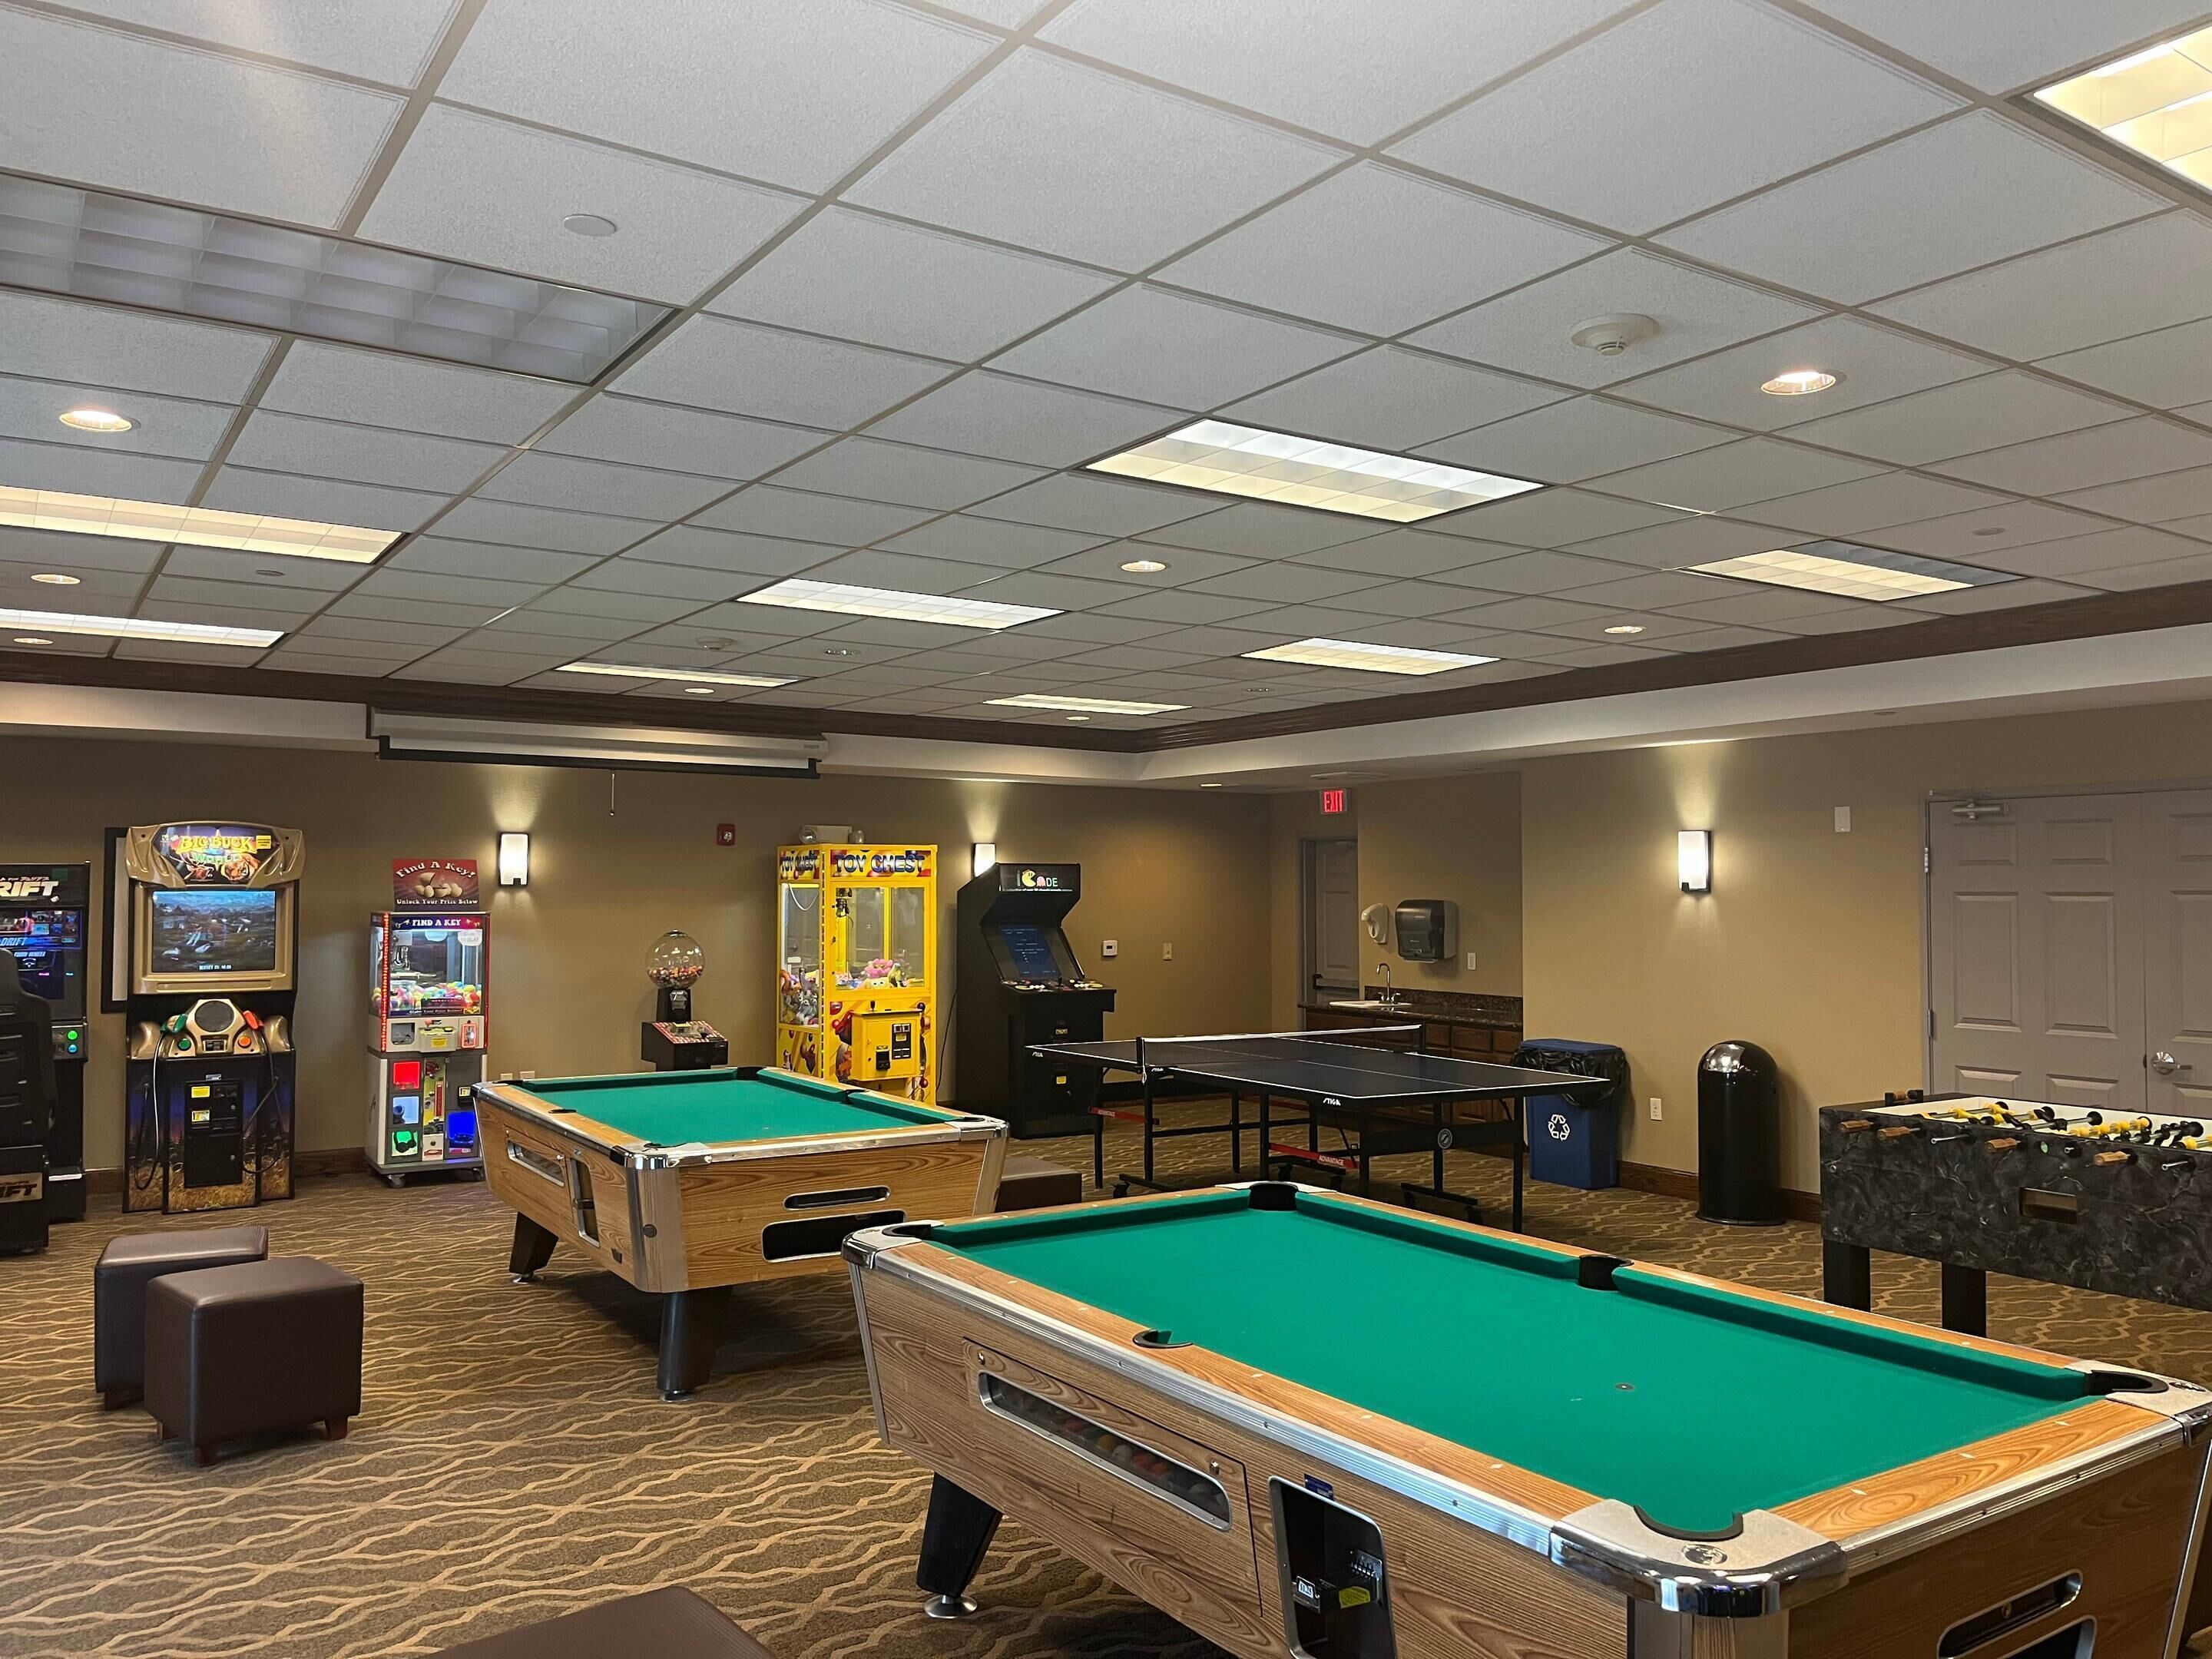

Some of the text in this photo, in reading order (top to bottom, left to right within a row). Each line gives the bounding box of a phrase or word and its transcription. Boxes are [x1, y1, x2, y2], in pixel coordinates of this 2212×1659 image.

[1323, 790, 1343, 813] EXIT
[180, 836, 210, 850] BIG
[211, 835, 253, 849] BUCK
[396, 863, 425, 877] Find
[445, 862, 475, 878] Key!
[780, 855, 794, 872] TOY
[835, 854, 925, 873] TOY CHEST
[0, 937, 28, 946] DRIFT
[1323, 1098, 1341, 1106] STIGA
[1319, 1155, 1344, 1167] ADVANTAGE
